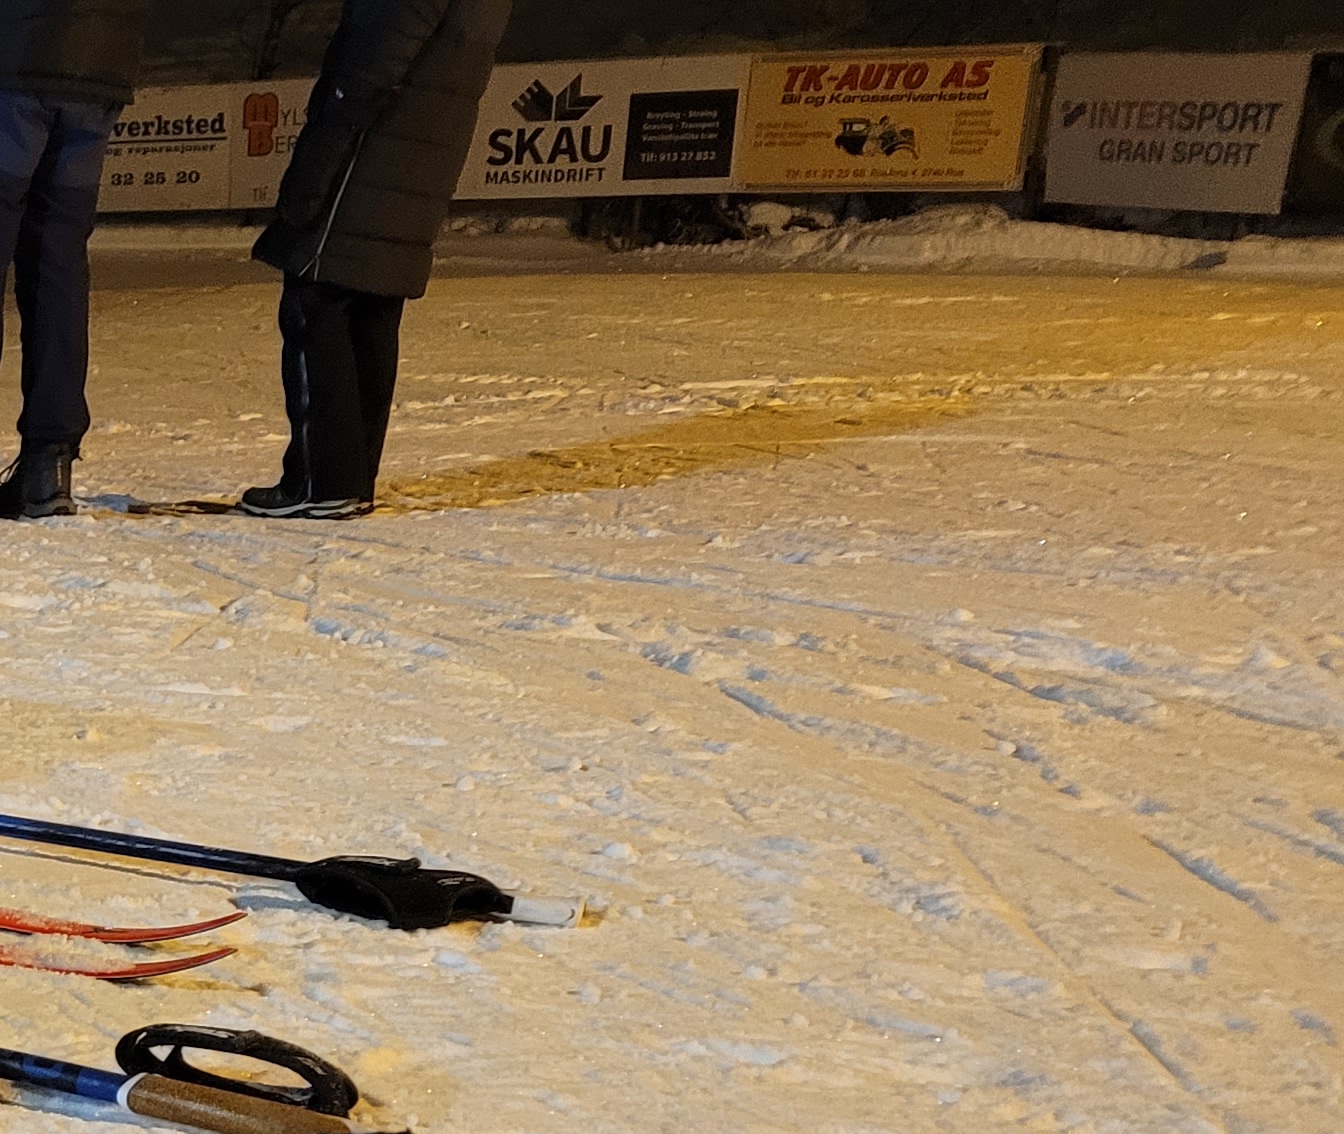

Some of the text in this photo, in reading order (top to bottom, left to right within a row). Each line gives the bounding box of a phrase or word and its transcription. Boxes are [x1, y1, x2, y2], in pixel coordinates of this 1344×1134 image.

[784, 62, 929, 92] TK-AUTO
[781, 93, 801, 104] Bil
[1085, 100, 1283, 133] INTERSPORT
[486, 124, 613, 166] SKAU
[1099, 138, 1261, 167] GRAN SPORT
[111, 172, 134, 186] 32
[176, 170, 201, 184] 20
[485, 167, 606, 185] MASKINDRIFT
